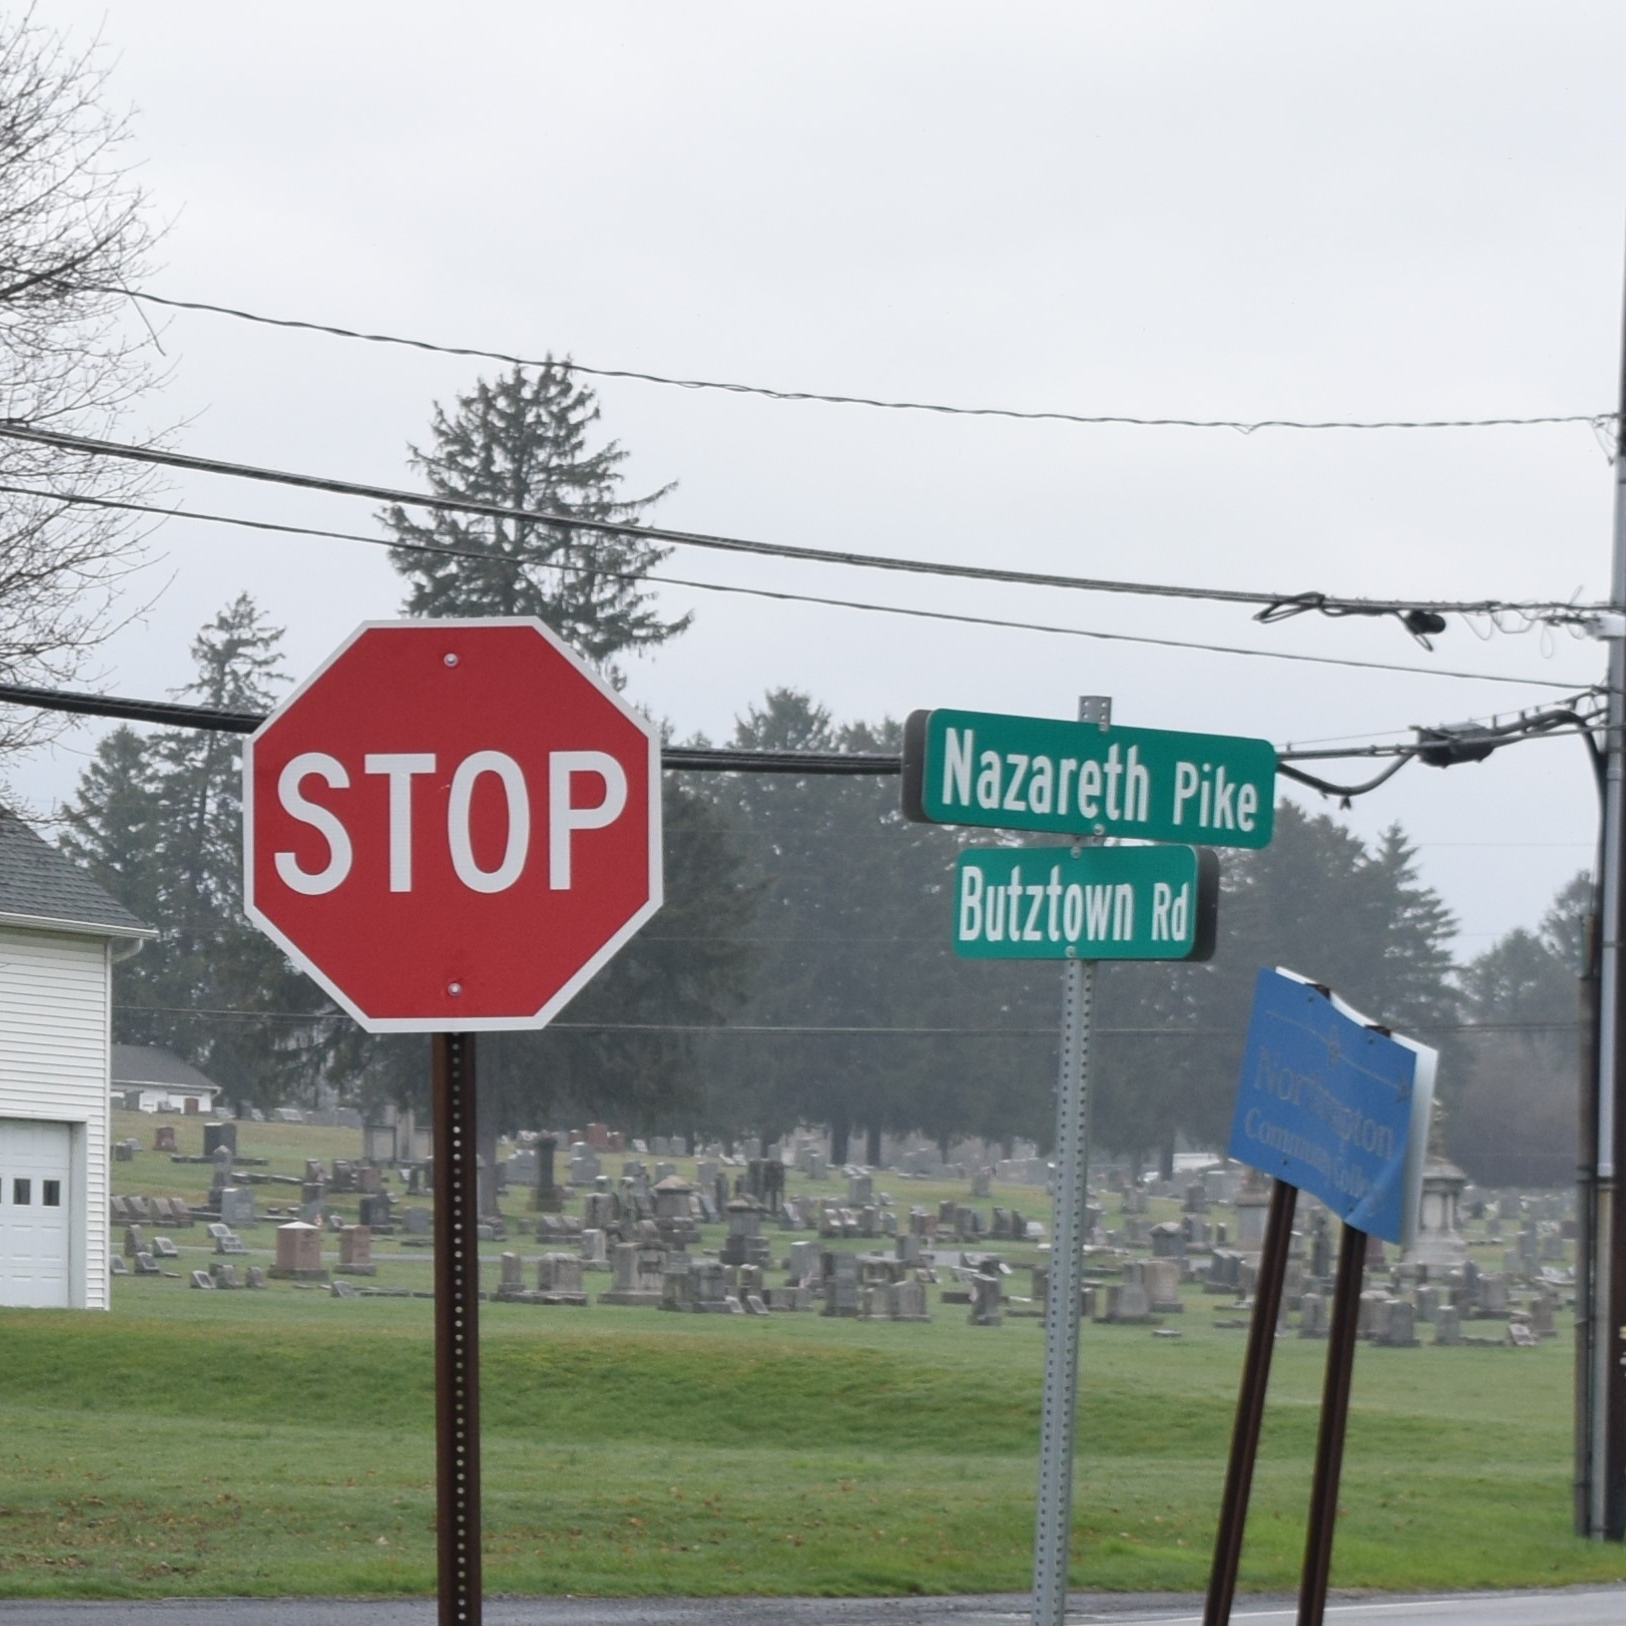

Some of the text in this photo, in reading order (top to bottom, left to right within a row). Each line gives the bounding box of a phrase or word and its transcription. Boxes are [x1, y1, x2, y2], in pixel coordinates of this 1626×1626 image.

[274, 750, 629, 896] STOP
[941, 726, 1258, 833] Nazareth Pike
[958, 864, 1190, 943] Butztown Rd
[1253, 1045, 1395, 1162] Norton
